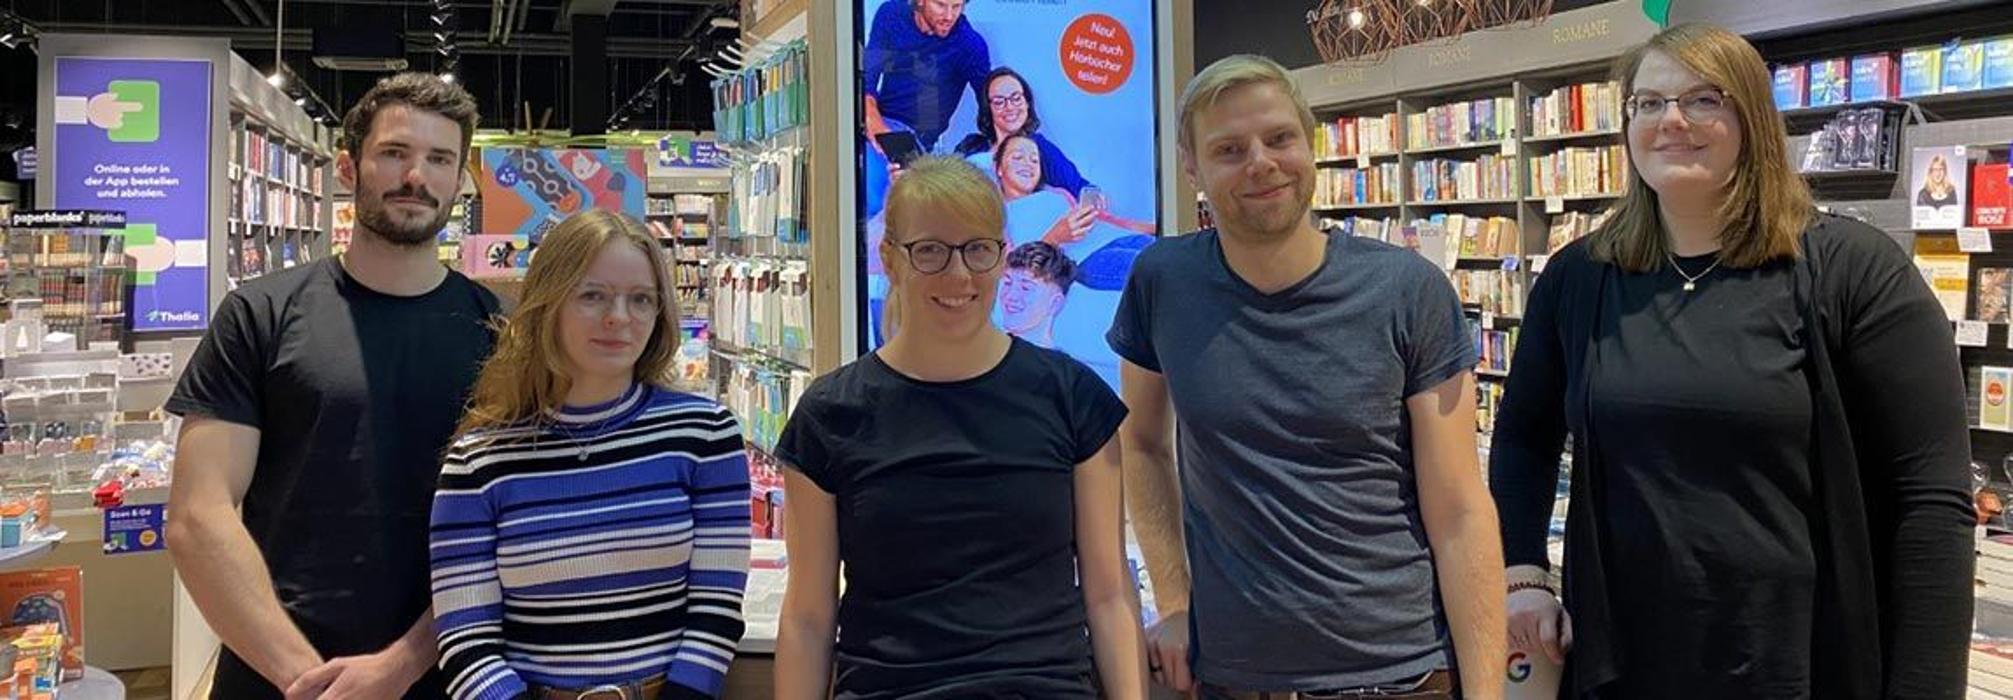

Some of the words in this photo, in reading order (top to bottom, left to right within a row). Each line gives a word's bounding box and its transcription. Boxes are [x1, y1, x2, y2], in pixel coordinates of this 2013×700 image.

[1090, 21, 1116, 38] Neu!
[1552, 19, 1610, 44] ROMANE
[1073, 35, 1097, 50] Jetzt
[1099, 43, 1124, 56] auch
[94, 164, 130, 174] Online
[132, 164, 157, 174] oder
[159, 163, 170, 174] in
[84, 176, 102, 187] der
[105, 176, 128, 187] App
[130, 176, 179, 187] bestellen
[97, 189, 118, 198] und
[160, 311, 199, 321] Thalia
[1507, 652, 1531, 683] G
